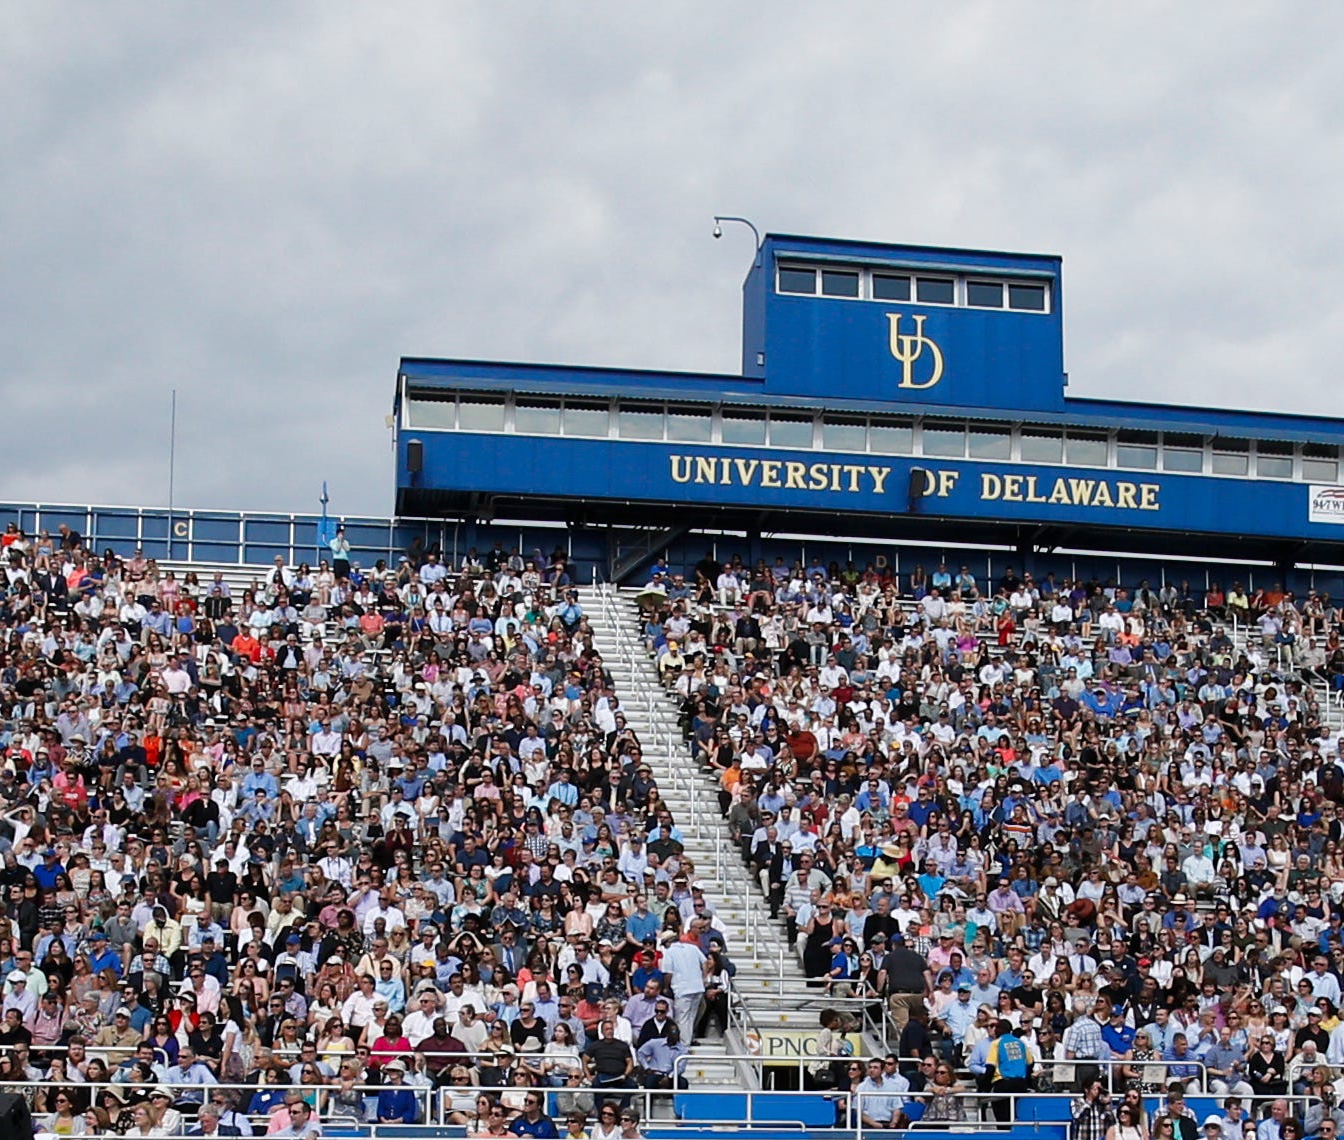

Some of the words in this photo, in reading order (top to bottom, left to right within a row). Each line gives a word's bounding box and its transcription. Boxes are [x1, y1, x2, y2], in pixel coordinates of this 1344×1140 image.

[885, 312, 944, 389] UD
[669, 454, 891, 494] UNIVERSITY
[980, 473, 1161, 511] DELAWARE
[174, 521, 188, 537] C
[875, 555, 887, 568] D
